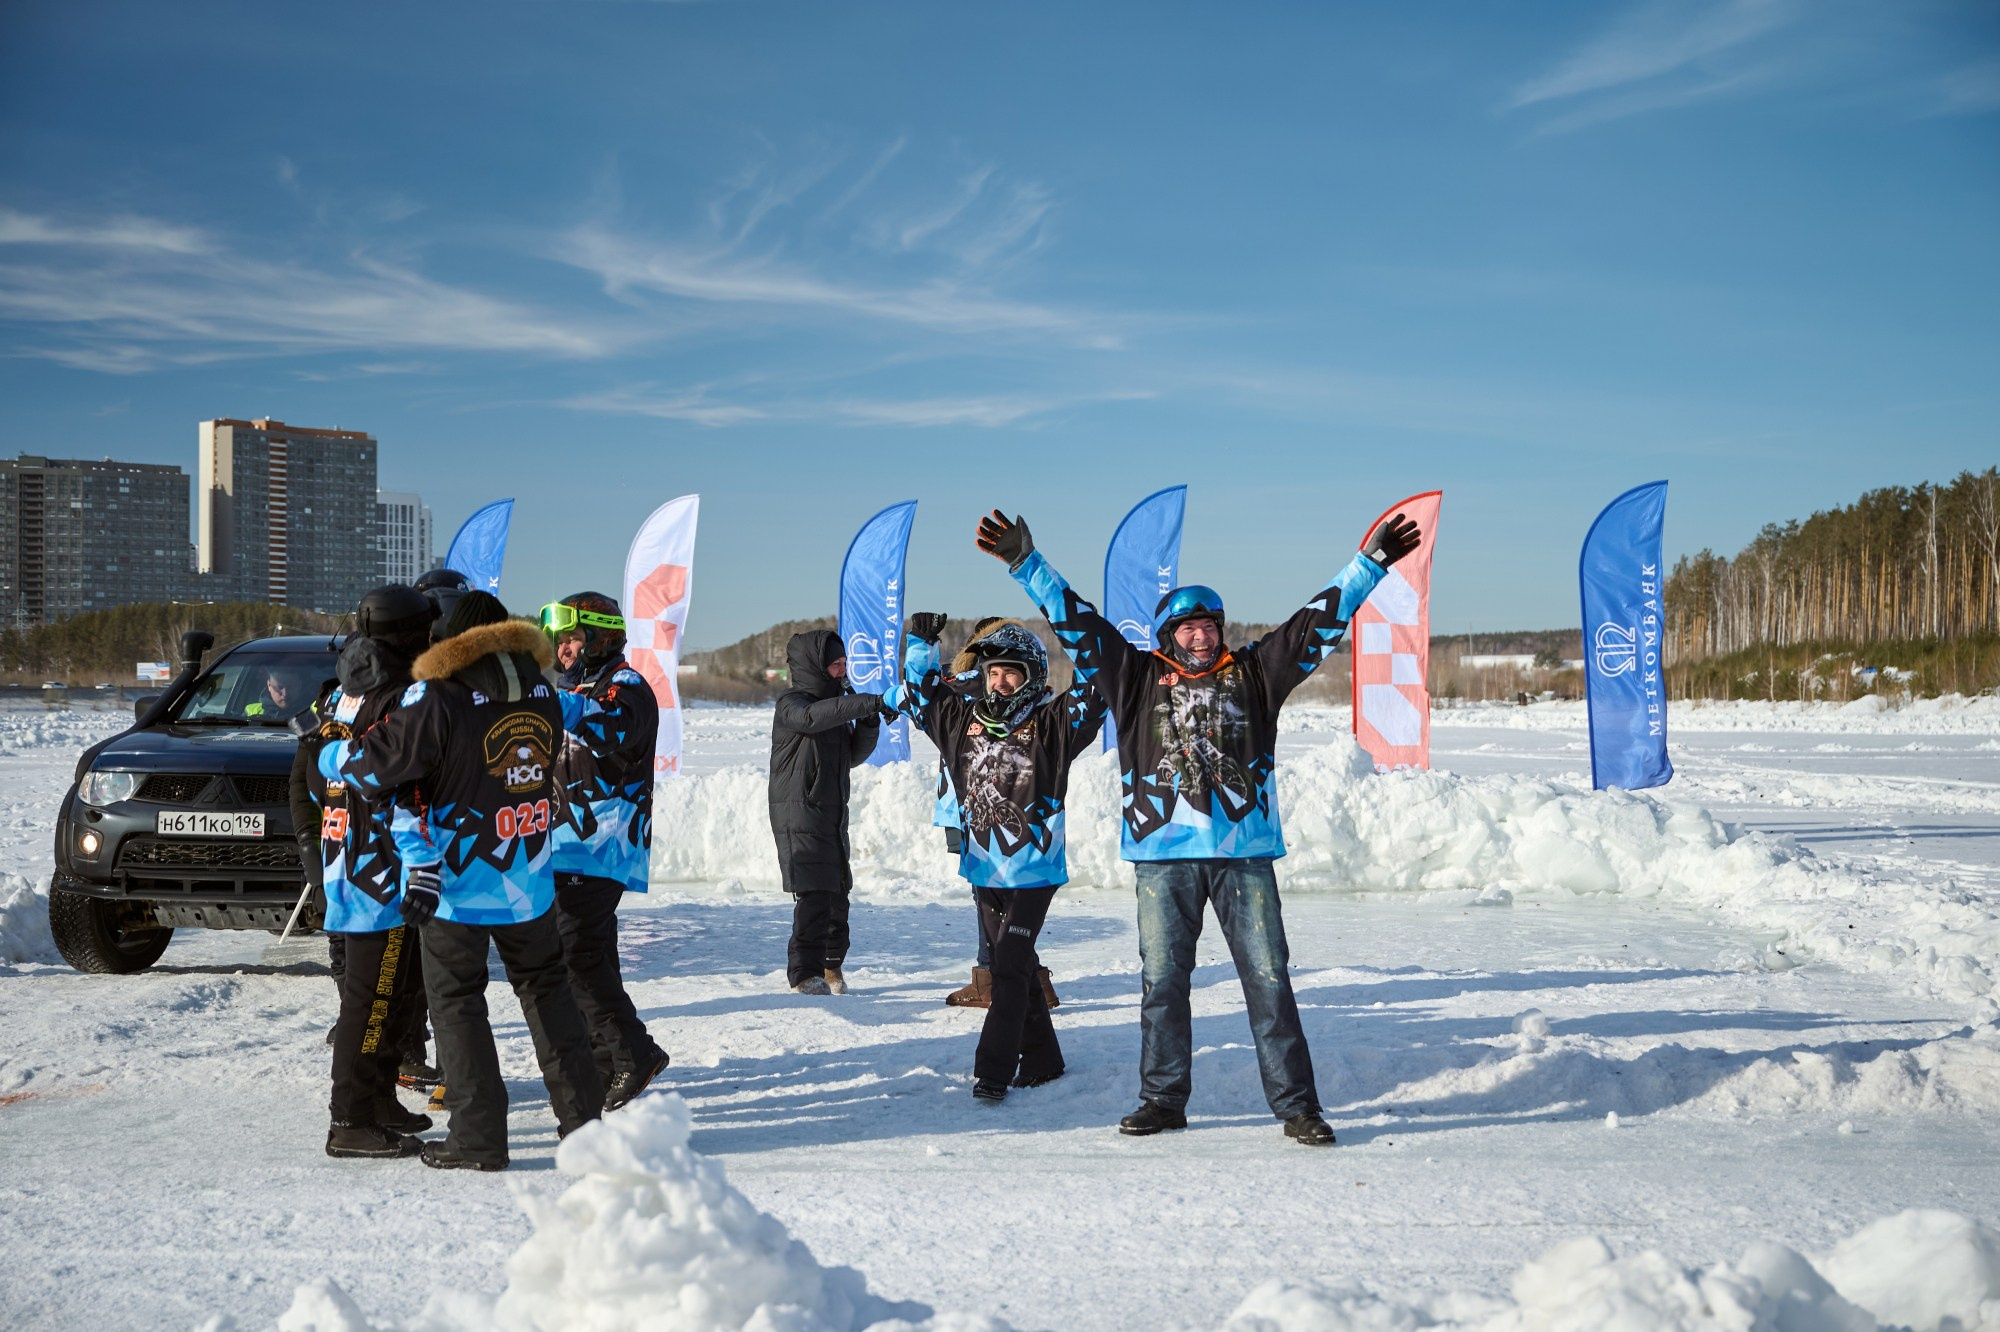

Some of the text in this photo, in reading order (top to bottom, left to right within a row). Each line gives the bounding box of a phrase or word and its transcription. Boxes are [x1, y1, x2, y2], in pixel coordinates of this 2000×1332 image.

[1641, 563, 1661, 736] МЕТКОМБАНК
[491, 716, 548, 740] KRASNODAR CHAPTER
[510, 725, 534, 736] RUSSIA
[506, 763, 543, 786] HOG
[163, 814, 260, 833] Н611КО 196
[496, 798, 550, 840] 023
[361, 925, 405, 1054] RASNODAR CHAPTER
